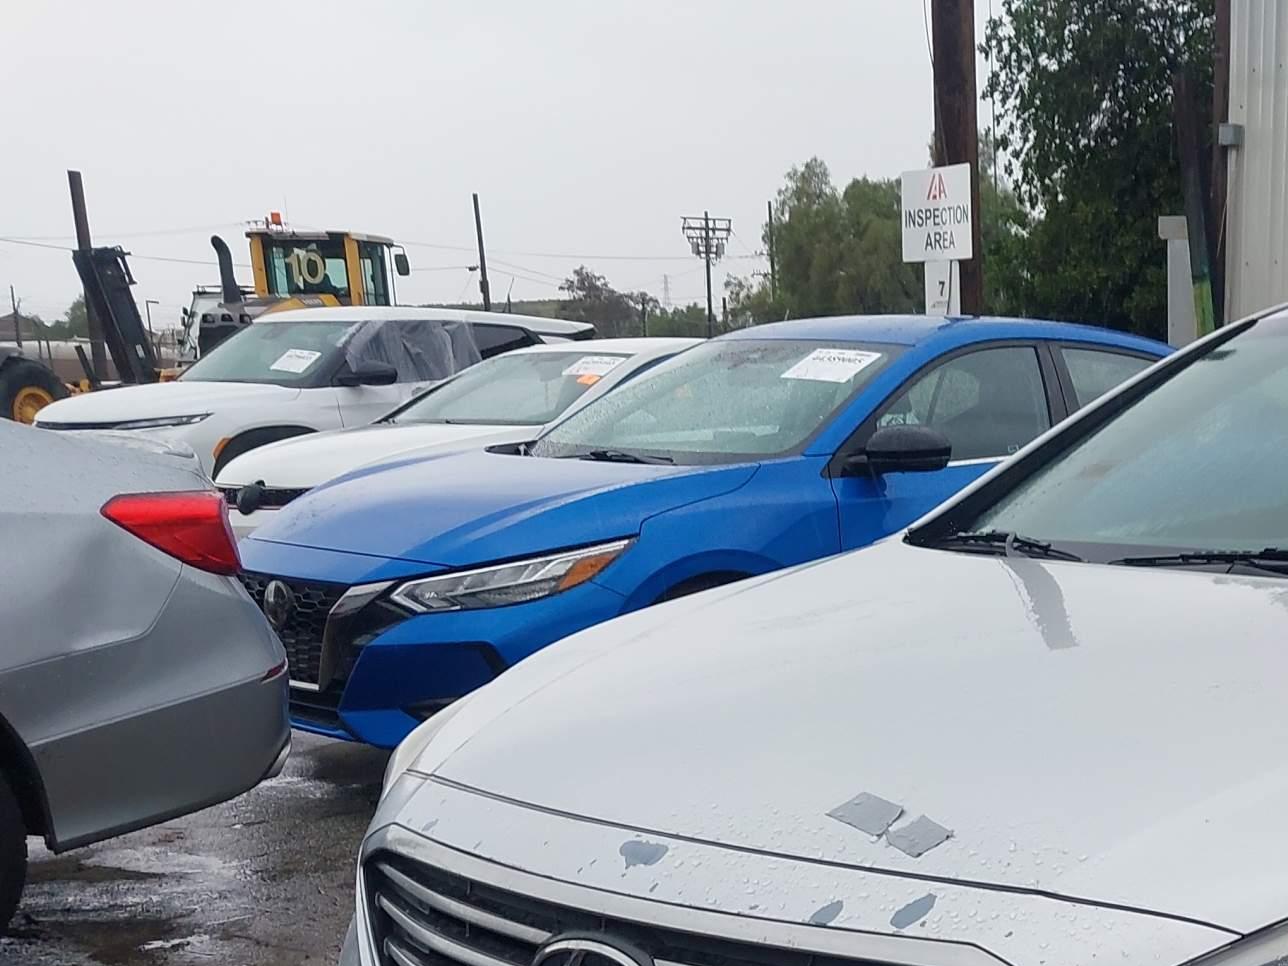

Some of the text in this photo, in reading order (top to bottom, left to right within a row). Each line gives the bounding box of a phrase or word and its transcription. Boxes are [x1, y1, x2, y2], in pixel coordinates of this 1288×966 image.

[904, 203, 969, 229] INSPECTION
[924, 230, 956, 251] AREA
[285, 248, 325, 288] 10
[938, 281, 946, 297] 7
